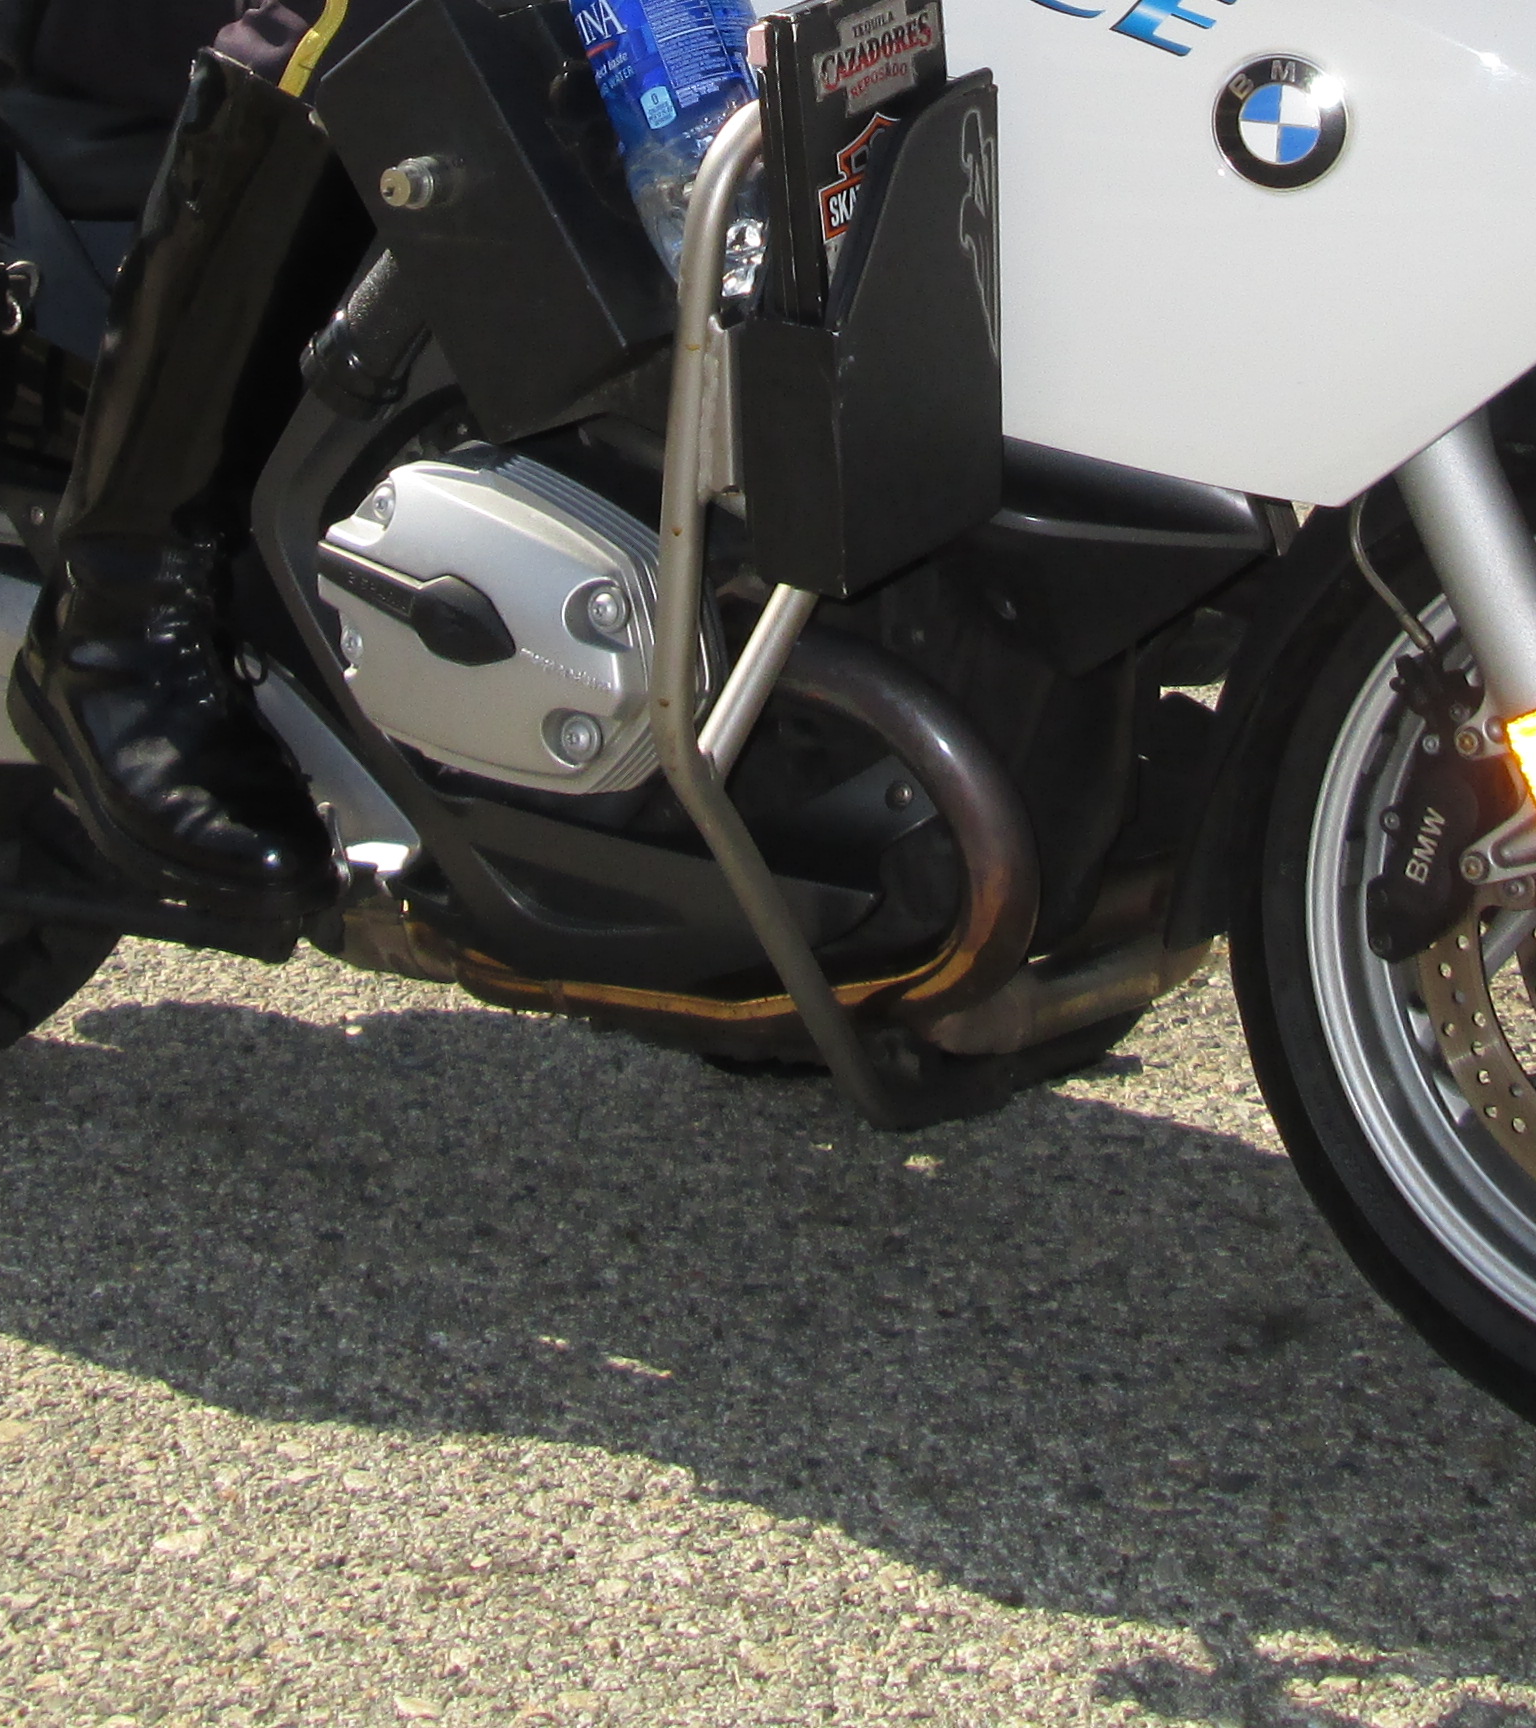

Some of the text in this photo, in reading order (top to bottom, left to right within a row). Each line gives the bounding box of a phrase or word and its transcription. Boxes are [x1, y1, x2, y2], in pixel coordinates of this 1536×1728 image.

[852, 11, 894, 38] TEQUILA
[818, 12, 932, 90] CAZADORES
[850, 62, 907, 97] REPOSADO
[1228, 59, 1322, 101] BM
[650, 93, 659, 105] 0
[1405, 806, 1445, 885] BMW
